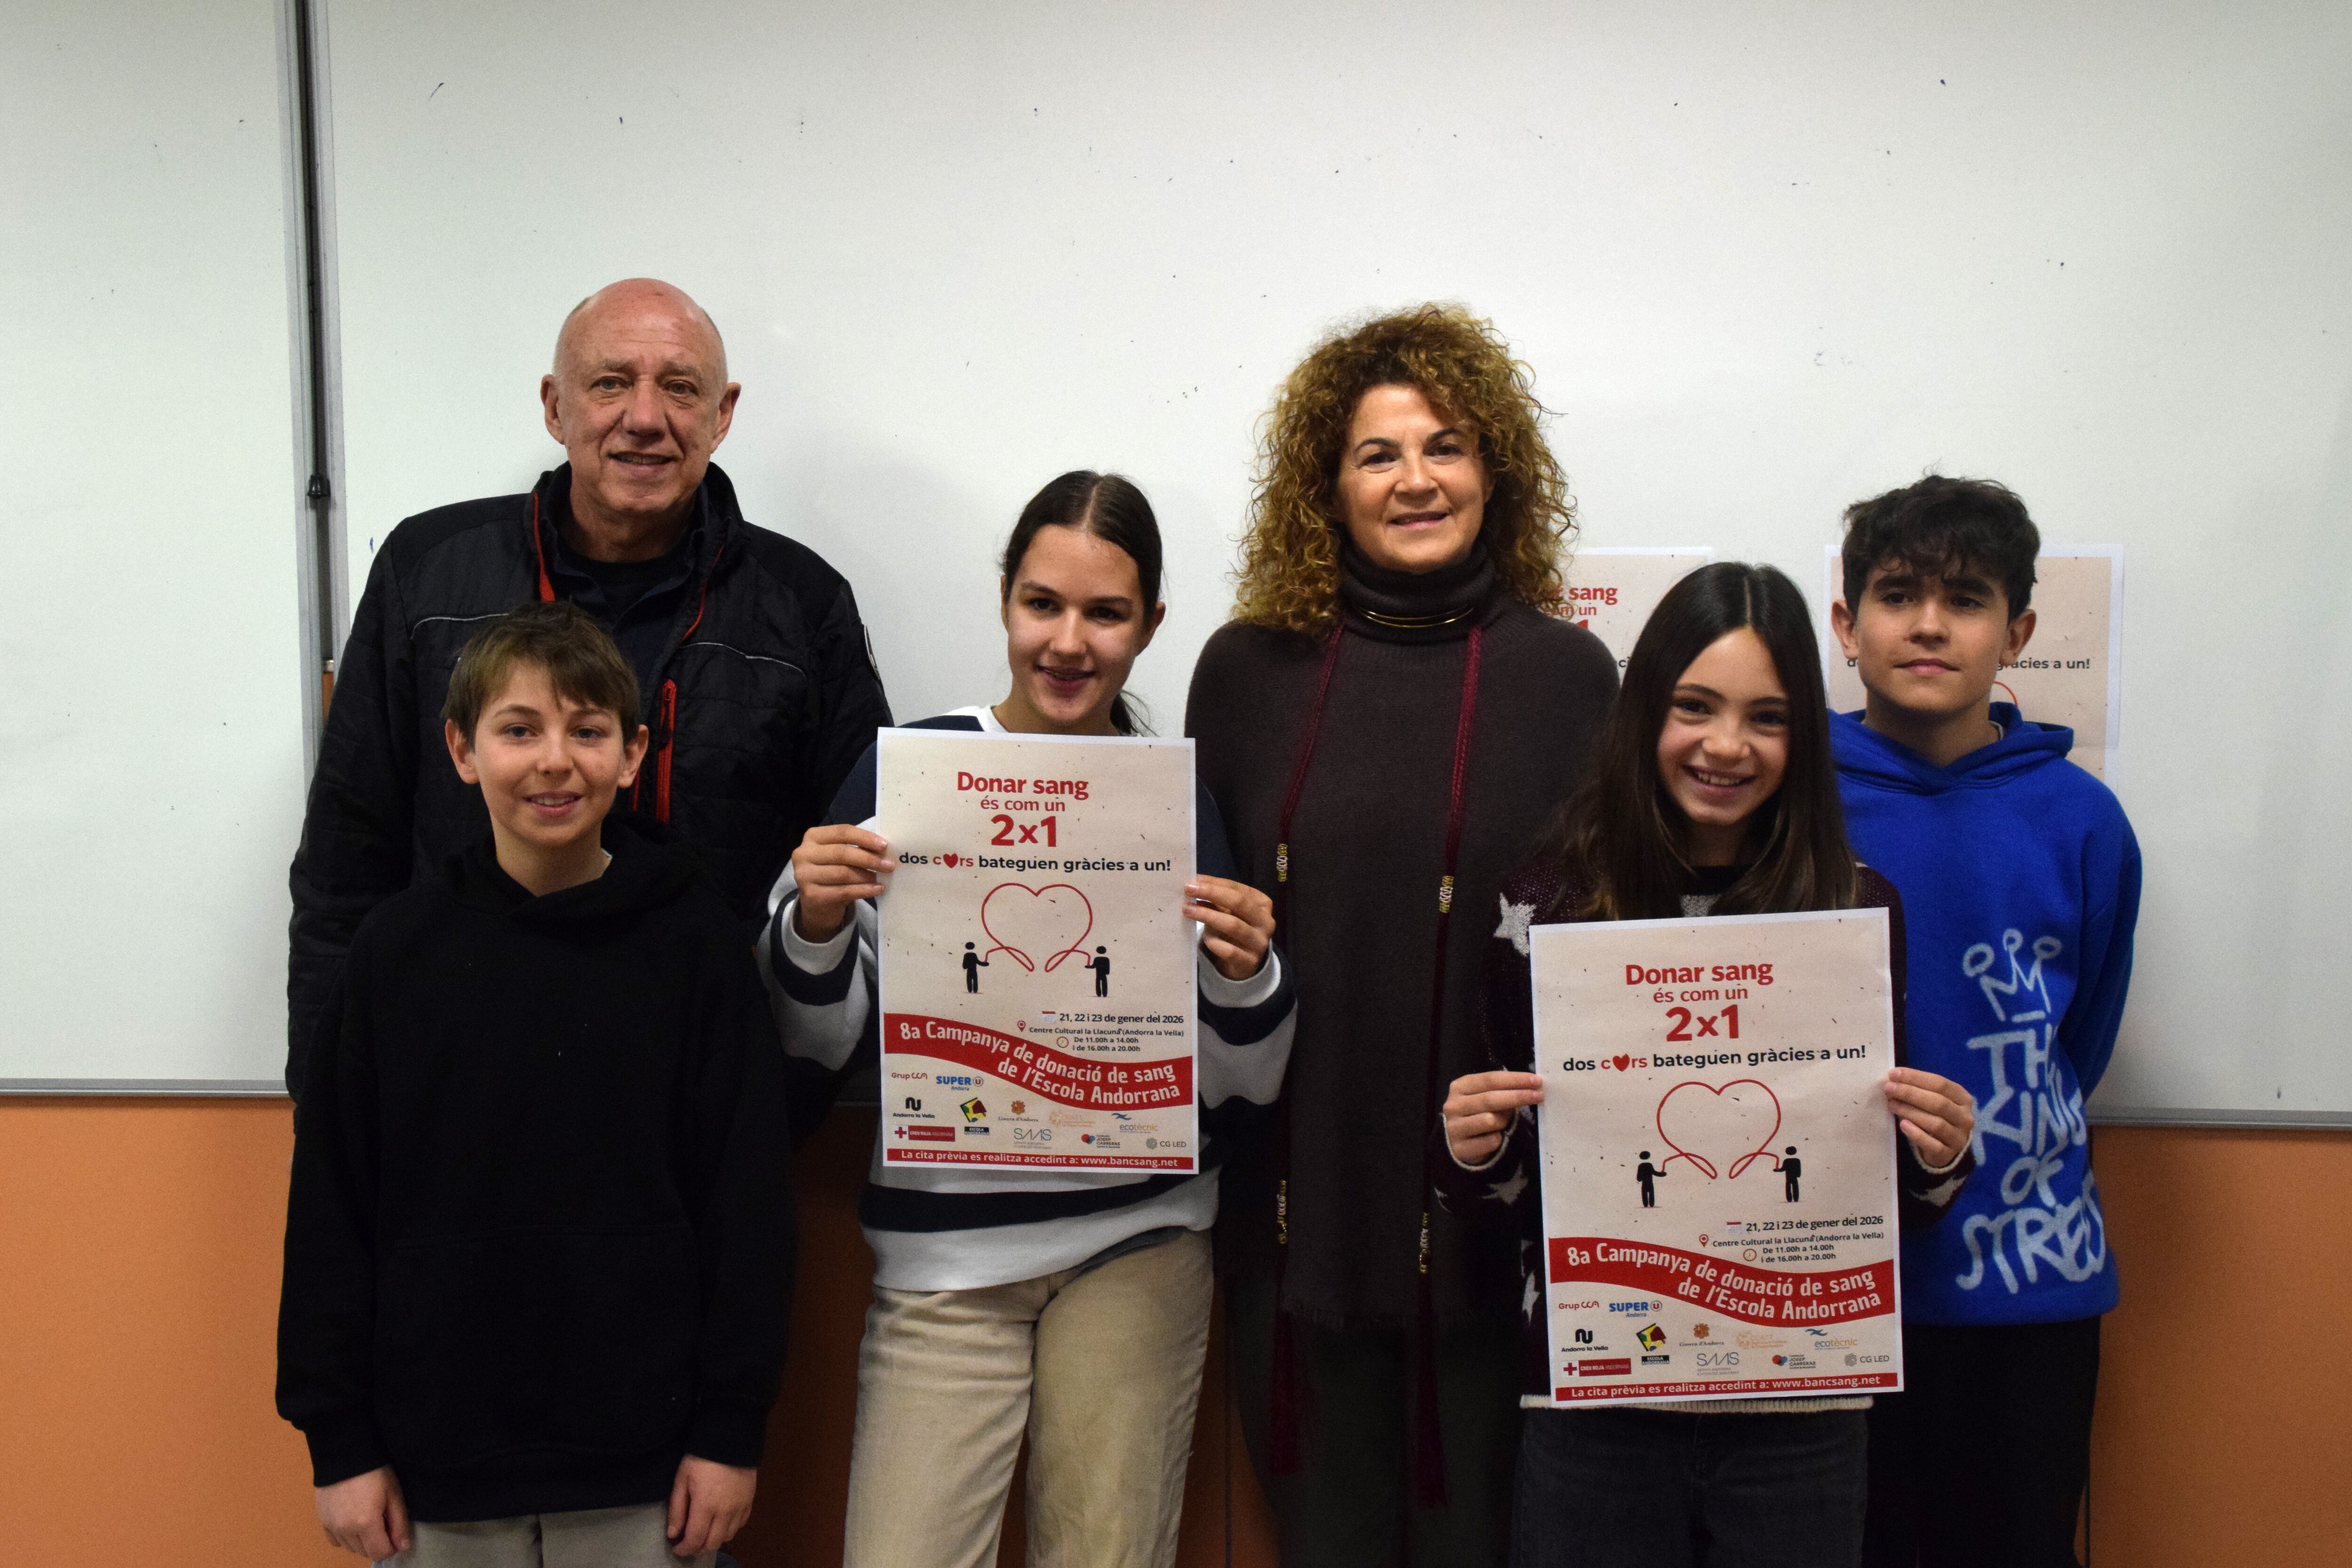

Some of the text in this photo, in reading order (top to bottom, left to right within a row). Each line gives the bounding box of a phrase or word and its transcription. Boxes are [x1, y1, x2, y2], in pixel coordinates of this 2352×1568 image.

[1569, 587, 1618, 605] sang
[1579, 606, 1597, 615] un
[2066, 658, 2090, 669] un!
[957, 771, 1089, 800] Donar sang
[980, 796, 1065, 812] és com un
[991, 814, 1057, 847] 2x1
[899, 852, 928, 865] dos
[979, 856, 1058, 872] bateguen
[1064, 857, 1124, 874] gràcies
[1130, 862, 1139, 871] a
[1144, 860, 1171, 871] un!
[1626, 963, 1774, 985] Donar sang
[1653, 987, 1748, 1003] és com un
[1059, 1013, 1073, 1022] 21,
[1104, 1014, 1115, 1022] de
[1118, 1016, 1144, 1025] gener
[1146, 1015, 1160, 1023] del
[1666, 1004, 1739, 1042] 2x1
[900, 1021, 1176, 1083] 8a Campanya de donació de sang
[1563, 1057, 1596, 1071] dos
[1653, 1051, 1741, 1068] bateguen
[1748, 1048, 1814, 1066] gràcies
[1820, 1050, 1831, 1059] a
[1836, 1045, 1866, 1059] un!
[936, 1075, 971, 1085] SUPER
[998, 1058, 1017, 1078] de
[1090, 1085, 1180, 1105] Andorrana
[915, 1151, 934, 1160] cita
[937, 1151, 968, 1162] prèvia
[984, 1153, 1021, 1162] realitza
[1024, 1154, 1067, 1164] accedint
[1081, 1156, 1178, 1168] www.bancsang.net
[1746, 1223, 1761, 1233] 21,
[1763, 1222, 1775, 1231] 22
[1782, 1221, 1794, 1230] 23
[1796, 1219, 1808, 1229] de
[1811, 1220, 1839, 1230] gener
[1842, 1217, 1857, 1226] del
[1859, 1216, 1883, 1226] 2026
[1816, 1234, 1851, 1242] (Andorra
[1567, 1243, 1876, 1297] 8a Campanya de donació de sang
[1609, 1302, 1649, 1312] SUPER
[1678, 1277, 1700, 1298] de
[1782, 1292, 1882, 1320] Andorrana
[1815, 1337, 1858, 1348] ecotècnic
[1571, 1388, 1584, 1397] La
[1587, 1386, 1608, 1396] cita
[1611, 1385, 1646, 1398] prèvia
[1663, 1383, 1706, 1393] realitza
[1708, 1381, 1756, 1391] accedint
[1772, 1376, 1881, 1389] www.bancsang.net
